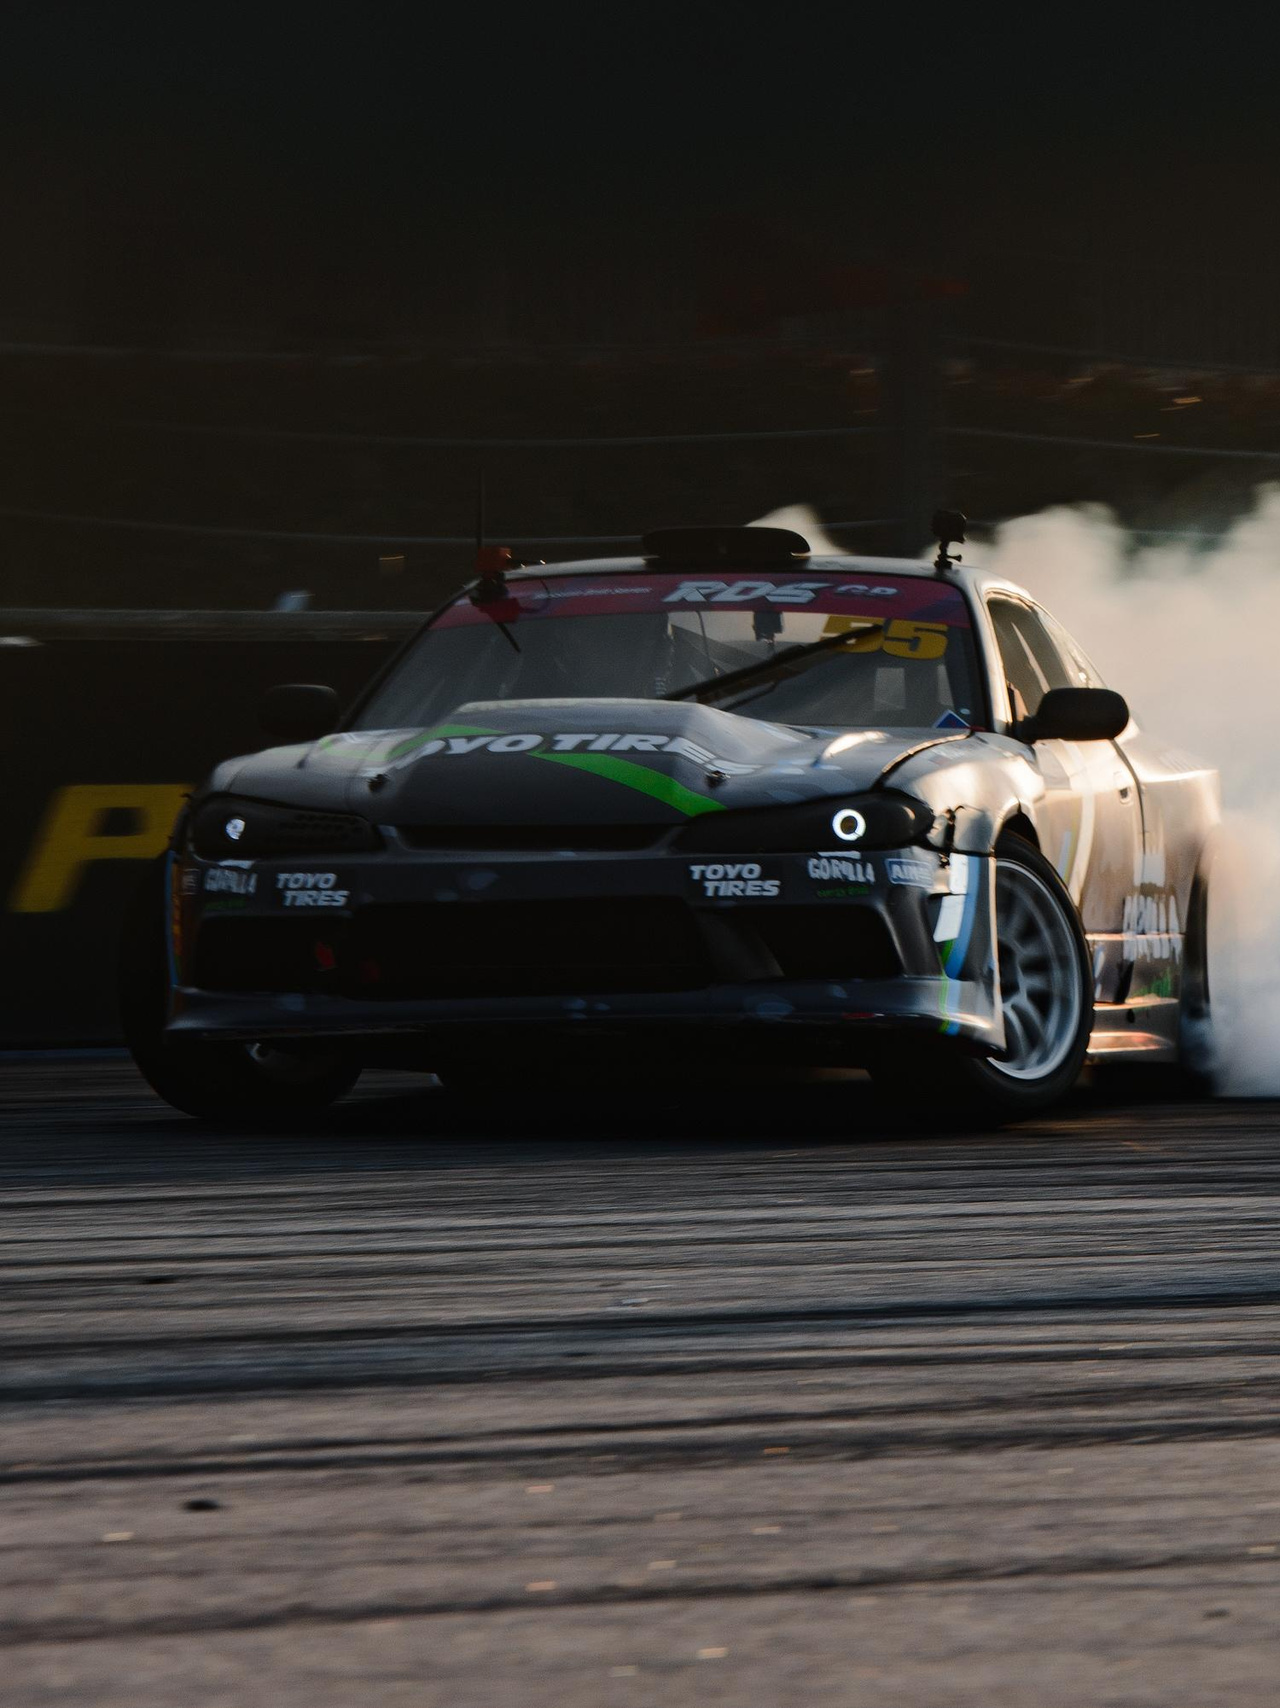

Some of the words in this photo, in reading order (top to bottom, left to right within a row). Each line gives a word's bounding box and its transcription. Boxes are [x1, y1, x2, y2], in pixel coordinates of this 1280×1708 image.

[662, 580, 835, 604] RDS
[689, 863, 762, 880] TOYO
[275, 873, 337, 889] TOYO
[703, 880, 781, 897] TIRES
[282, 890, 349, 907] TIRES
